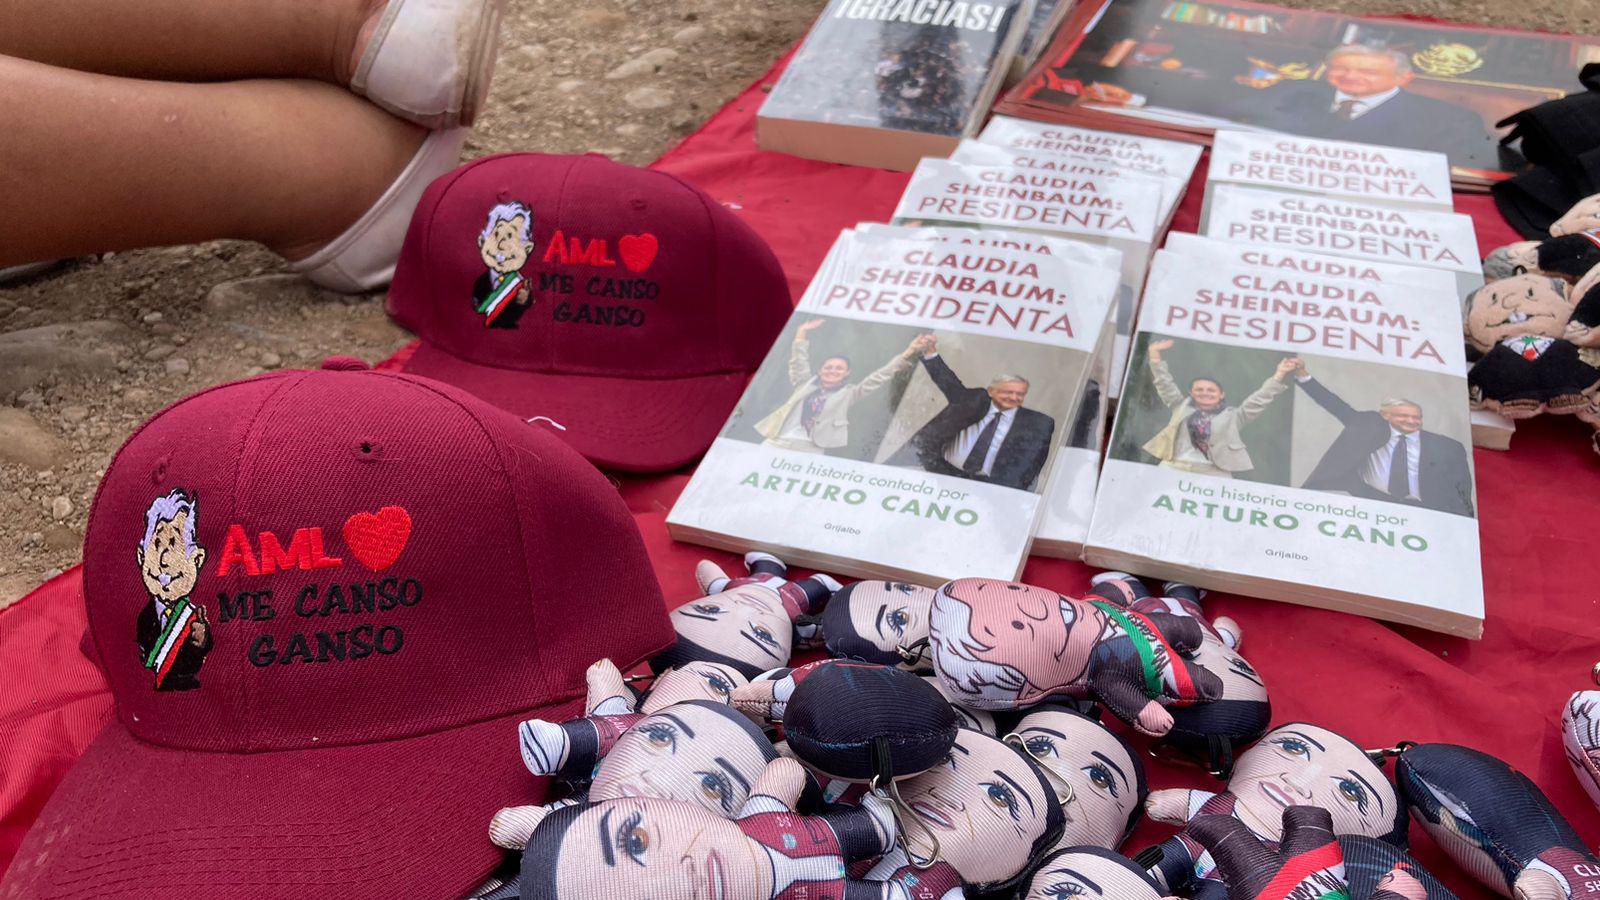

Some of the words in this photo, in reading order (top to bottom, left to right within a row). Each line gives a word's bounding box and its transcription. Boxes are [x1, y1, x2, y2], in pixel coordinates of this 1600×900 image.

[1012, 138, 1165, 165] SHEINBAUM:
[1041, 130, 1142, 150] CLAUDIA
[1276, 141, 1389, 164] CLAUDIA
[979, 171, 1098, 192] CLAUDIA
[1228, 163, 1436, 199] PRESIDENTA
[1248, 151, 1417, 180] SHEINBAUM:
[945, 182, 1124, 211] SHEINBAUM:
[1280, 199, 1407, 224] CLAUDIA
[917, 197, 1137, 234] PRESIDENTA
[1250, 209, 1441, 243] SHEINBAUM:
[1228, 223, 1463, 266] PRESIDENTA
[904, 250, 1039, 279] CLAUDIA
[1241, 252, 1382, 282] CLAUDIA
[539, 273, 575, 294] ME
[586, 277, 660, 300] CANSO
[861, 267, 1068, 306] SHEINBAUM:
[1232, 274, 1384, 307] CLAUDIA
[553, 302, 646, 328] GANSO
[823, 284, 1075, 338] PRESIDENTA
[1195, 288, 1422, 332] SHEINBAUM:
[1165, 304, 1447, 366] PRESIDENTA
[770, 457, 802, 473] Una
[806, 464, 864, 484] historia
[868, 476, 934, 496] contada
[937, 487, 969, 501] por
[739, 471, 867, 506] ARTURO
[881, 495, 979, 527] CANO
[1178, 480, 1214, 497] Una
[1221, 486, 1288, 508] historia
[1293, 501, 1368, 520] contada
[1375, 512, 1408, 526] por
[824, 522, 861, 536] Grijalbo
[1152, 494, 1299, 531] ARTURO
[1317, 520, 1429, 553] CANO
[1264, 548, 1309, 562] Grijalbo
[217, 588, 275, 623] ME
[294, 577, 423, 618] CANSO
[248, 625, 404, 666] GANSO
